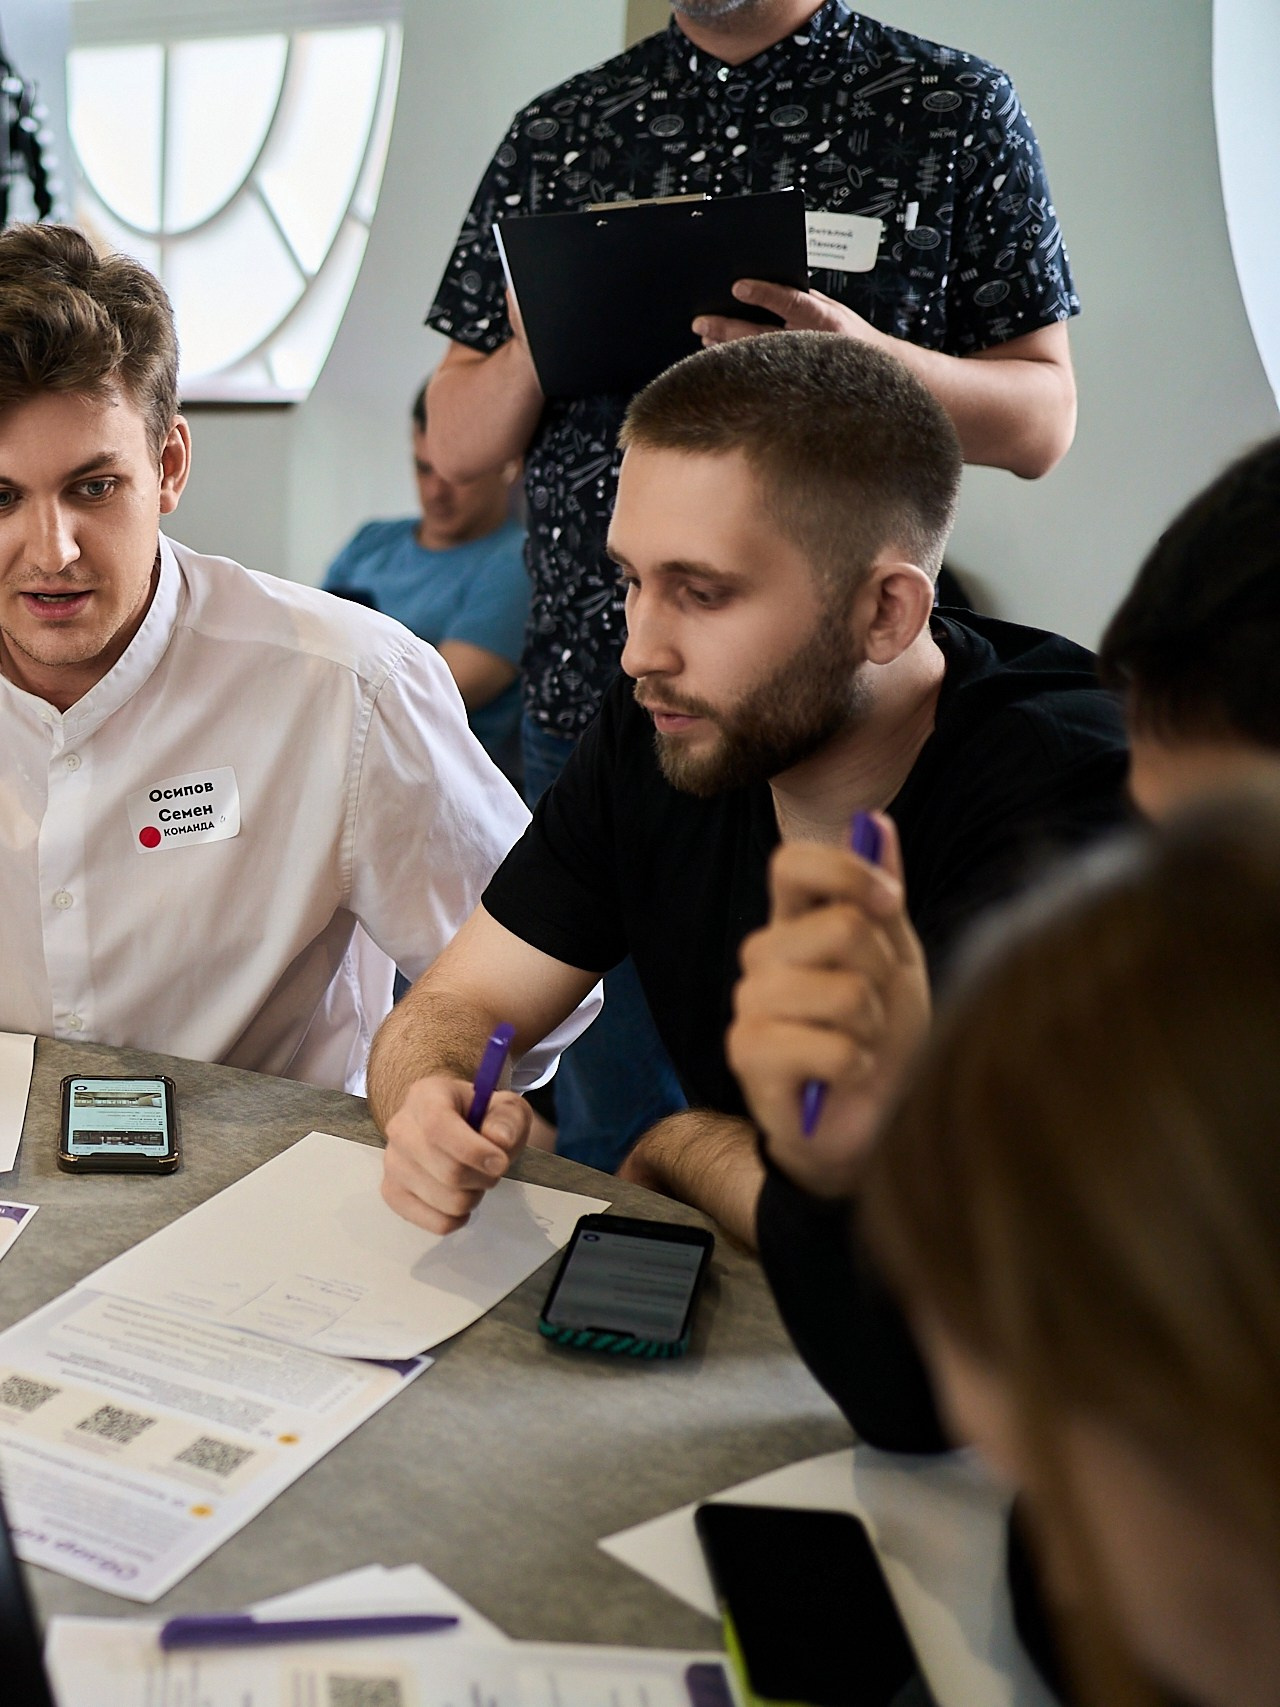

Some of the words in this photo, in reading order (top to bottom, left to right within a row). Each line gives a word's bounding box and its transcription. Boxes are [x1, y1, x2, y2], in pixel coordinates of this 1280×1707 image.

[149, 782, 214, 803] Осипов
[158, 804, 213, 822] Семен
[163, 821, 215, 837] КОМАНДА
